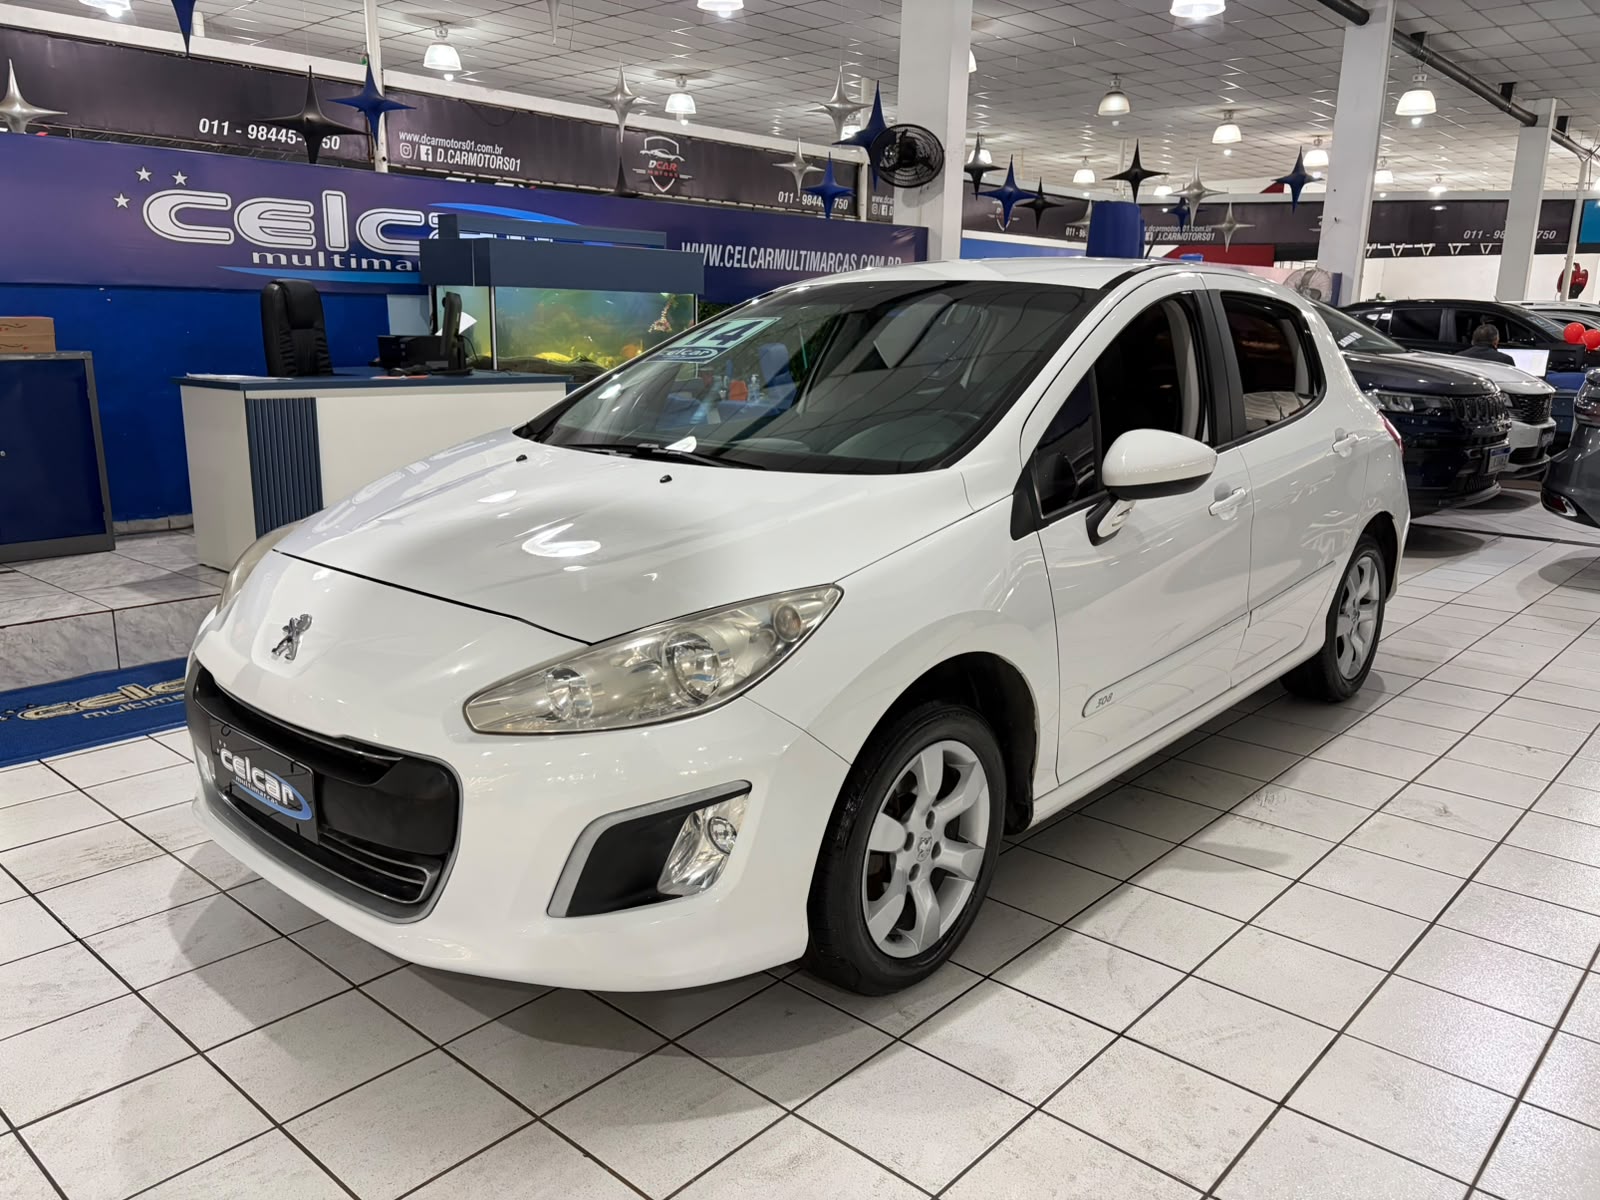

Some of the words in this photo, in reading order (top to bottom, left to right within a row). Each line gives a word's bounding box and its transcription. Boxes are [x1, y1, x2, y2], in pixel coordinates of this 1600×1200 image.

[198, 117, 229, 136] 011
[247, 124, 341, 150] 98445-50
[398, 131, 503, 155] www.dcarmotors01.com.br
[436, 148, 521, 172] D.CARMOTORS01
[648, 160, 678, 171] DCAR
[777, 191, 794, 204] 011
[801, 194, 849, 210] 9844750
[142, 188, 480, 256] celc
[1463, 230, 1482, 239] 011
[681, 242, 903, 272] W.CELCARMULTIMARCASCOM
[684, 320, 764, 346] 14
